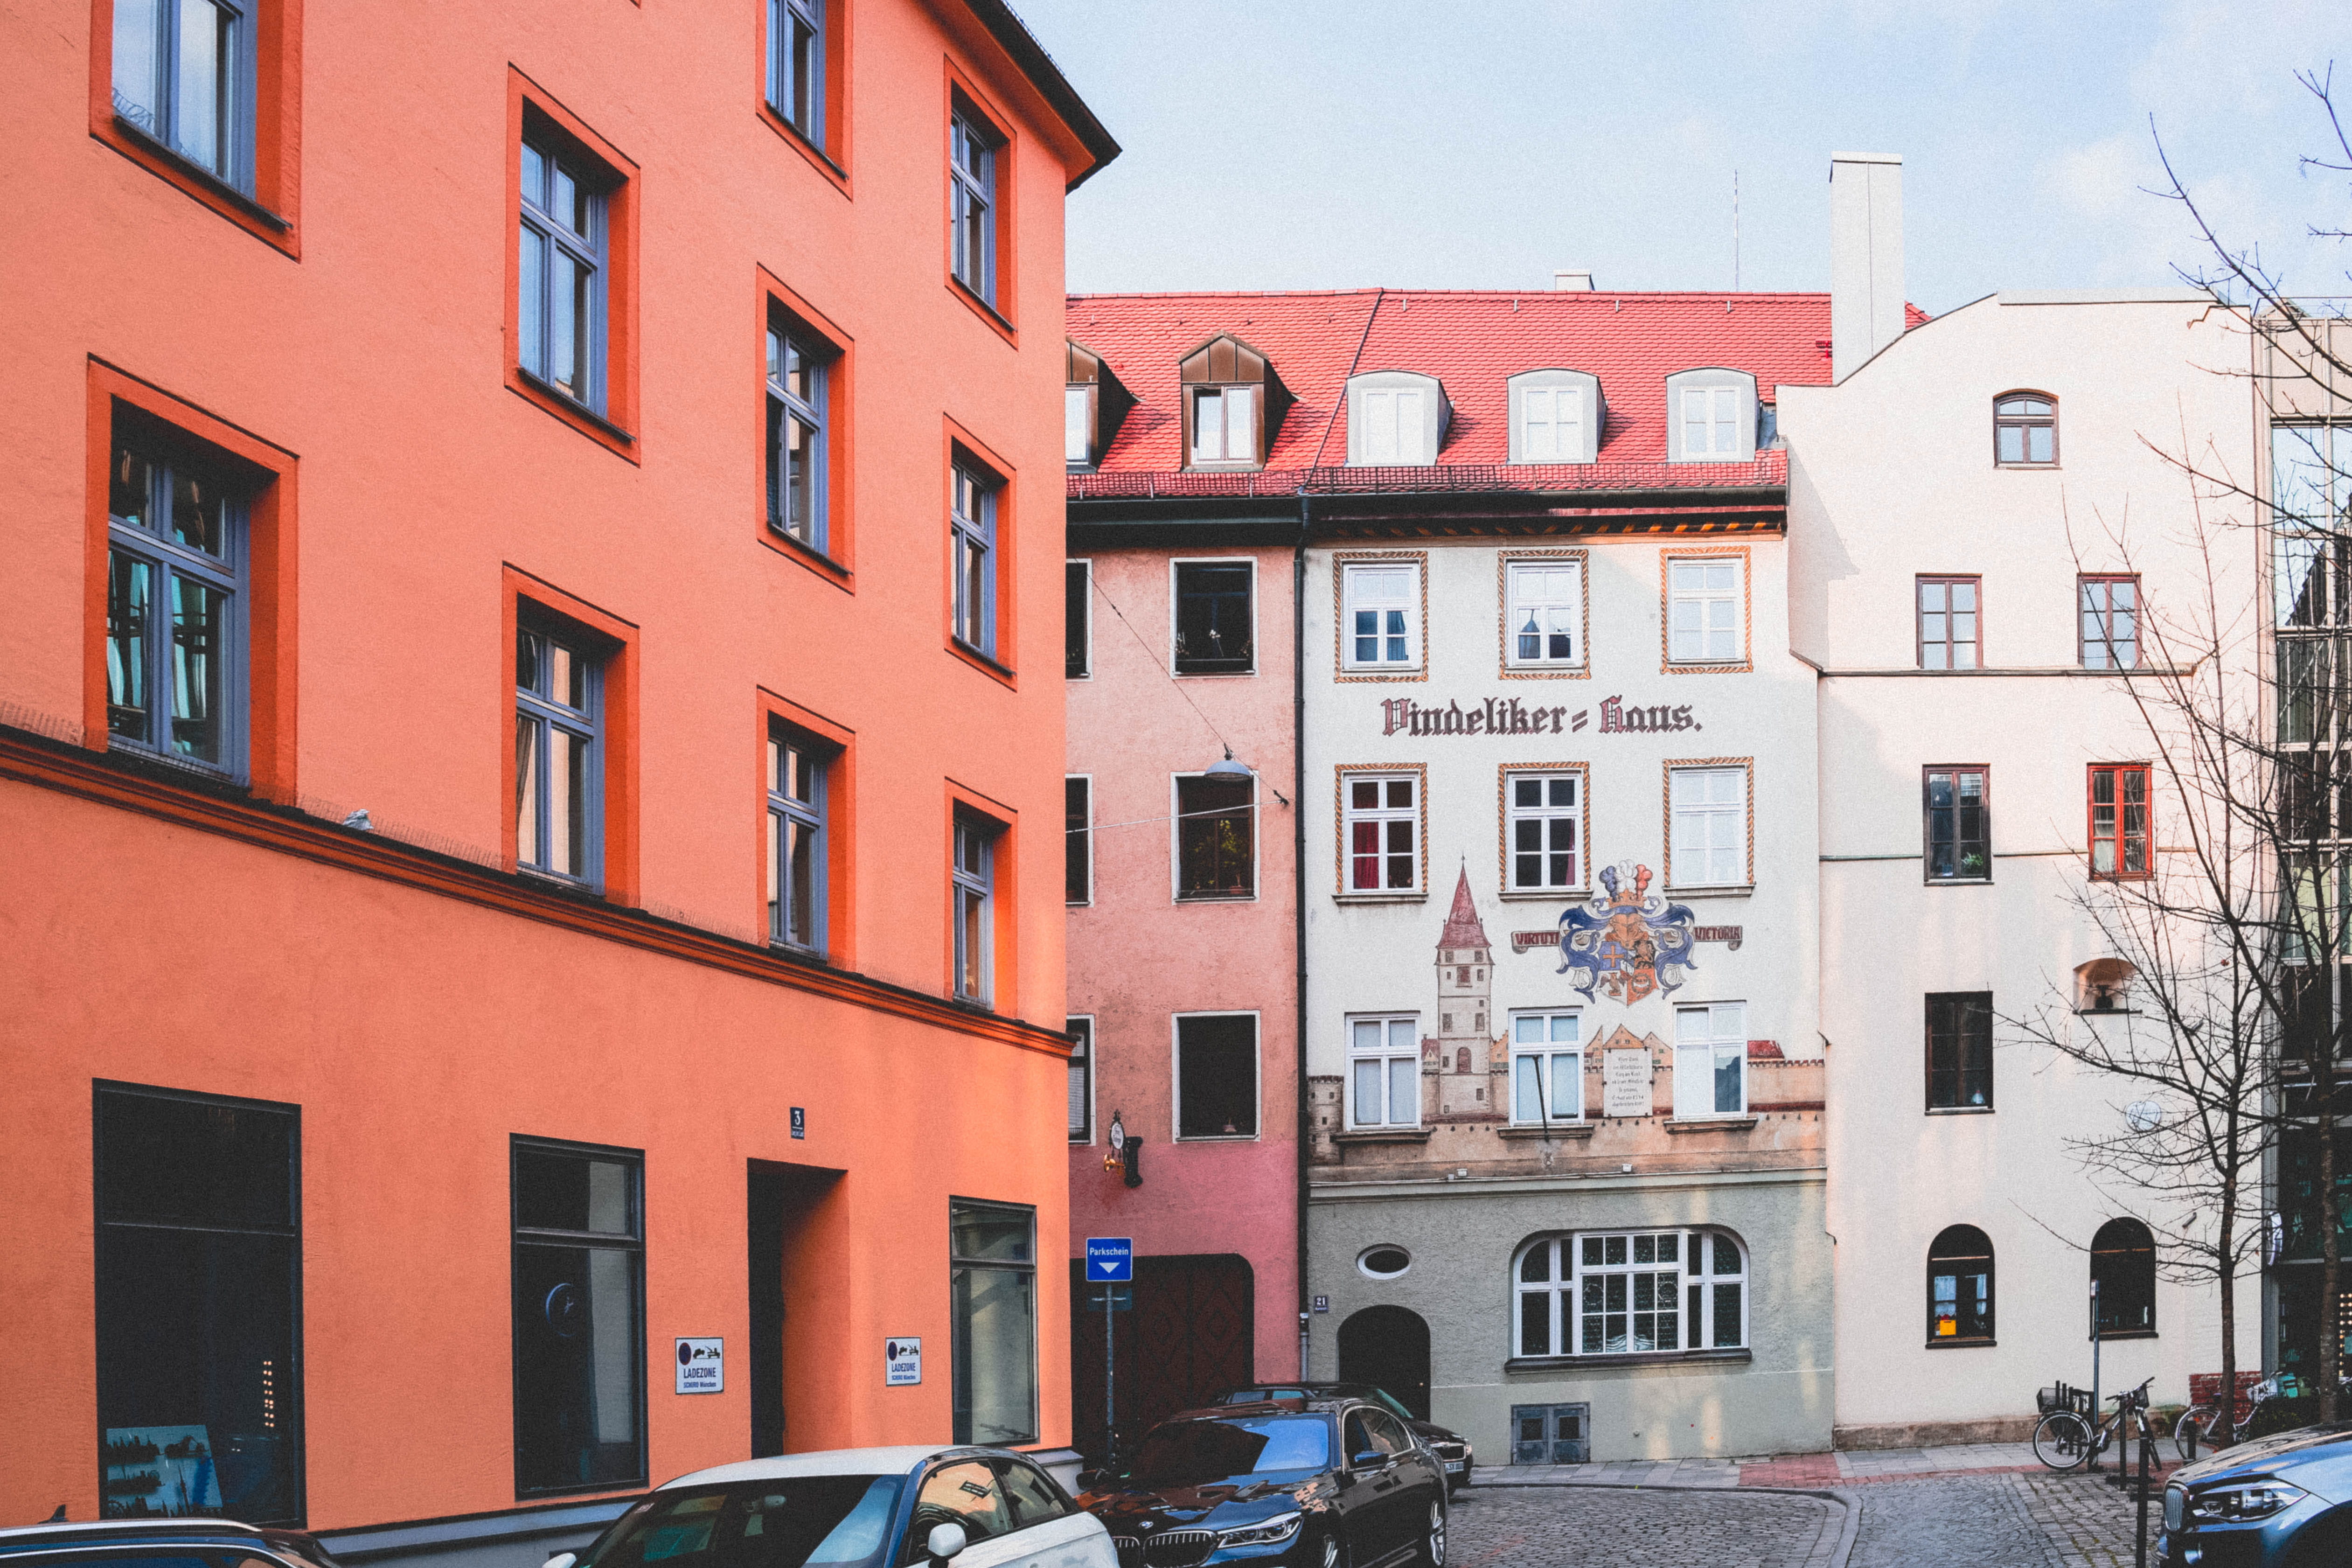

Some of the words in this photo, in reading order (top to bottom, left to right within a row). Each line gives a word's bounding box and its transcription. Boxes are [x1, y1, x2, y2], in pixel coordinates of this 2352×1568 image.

[1694, 926, 1740, 940] VICTORIA
[794, 1110, 800, 1125] 3
[1090, 1247, 1129, 1255] Parkschein
[683, 1367, 717, 1379] LADEZONE
[891, 1363, 916, 1372] LADEZONE
